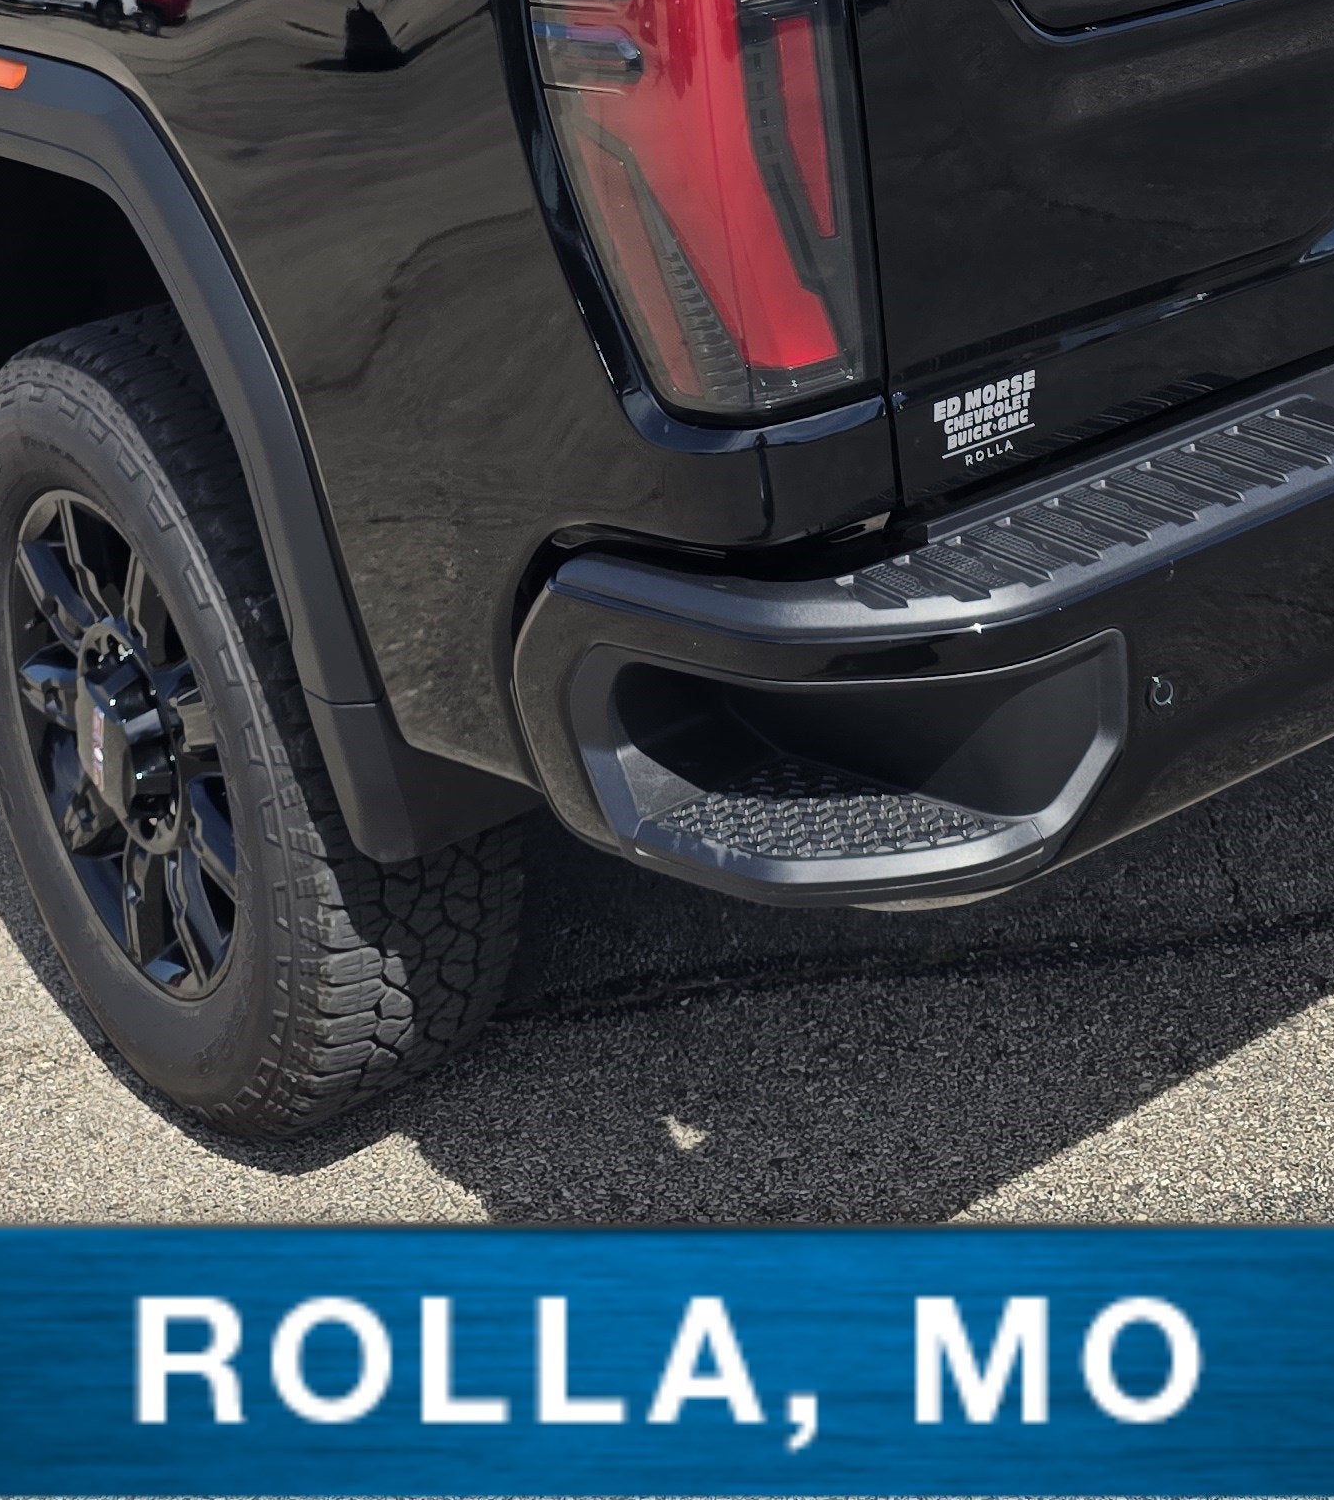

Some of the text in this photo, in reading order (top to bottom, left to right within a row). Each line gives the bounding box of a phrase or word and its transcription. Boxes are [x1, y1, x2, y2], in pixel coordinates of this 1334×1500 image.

[933, 369, 1036, 423] ED MORSE
[943, 391, 1031, 435] CHEVROLET
[964, 439, 1014, 467] ROLLA
